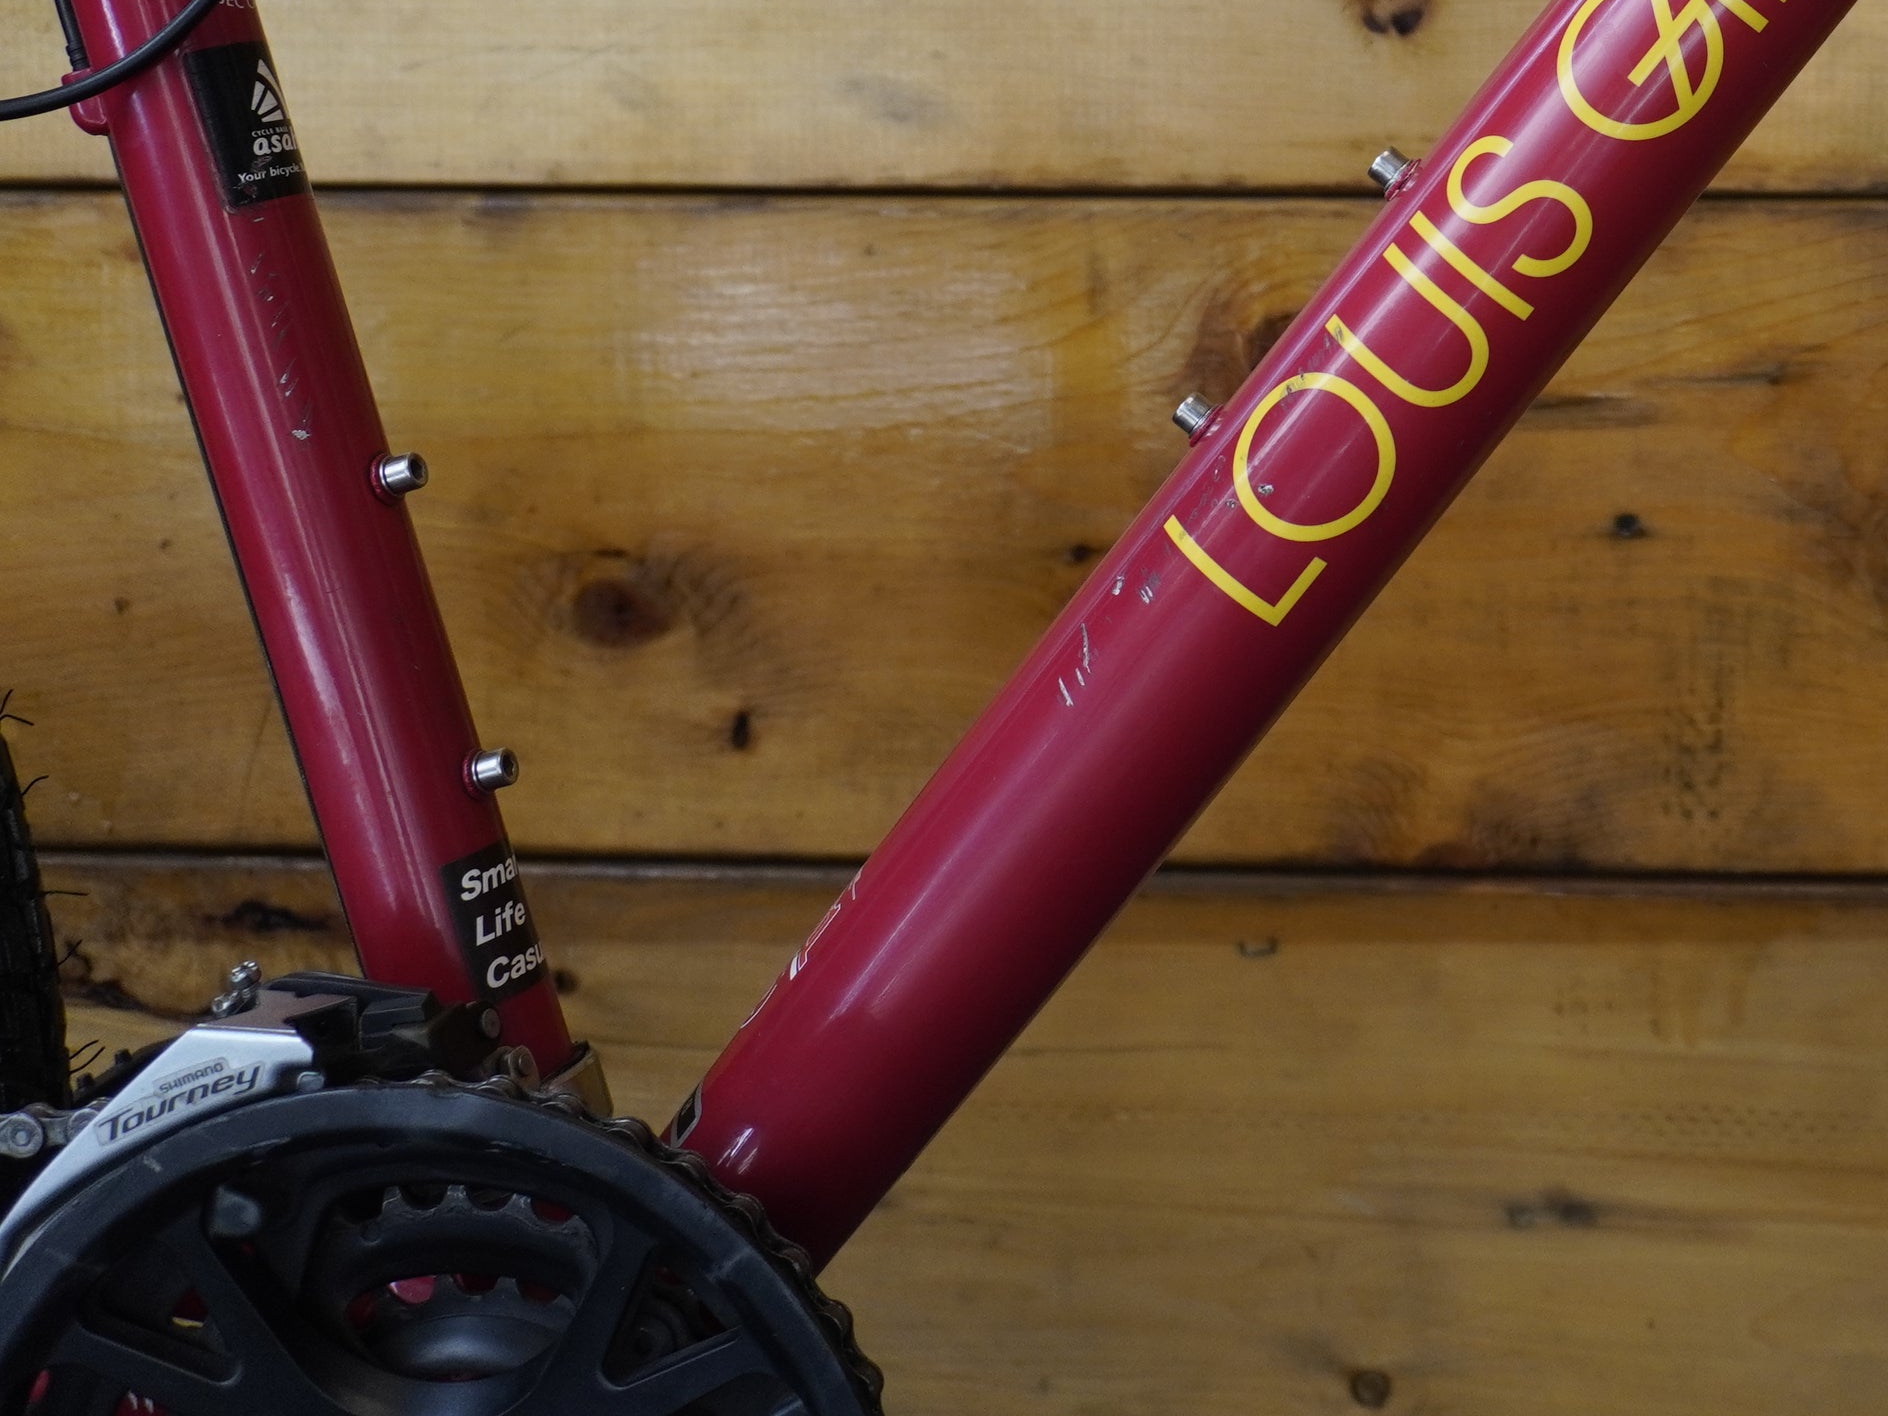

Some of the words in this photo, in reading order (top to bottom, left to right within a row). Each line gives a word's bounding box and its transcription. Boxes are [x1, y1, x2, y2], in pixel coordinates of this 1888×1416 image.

[253, 132, 297, 156] asa
[237, 170, 267, 183] Your
[1163, 133, 1594, 627] LOUIS
[460, 852, 519, 902] Sma
[475, 899, 526, 947] Life
[159, 1062, 224, 1094] SHIMANO
[99, 1065, 261, 1141] Tourney
